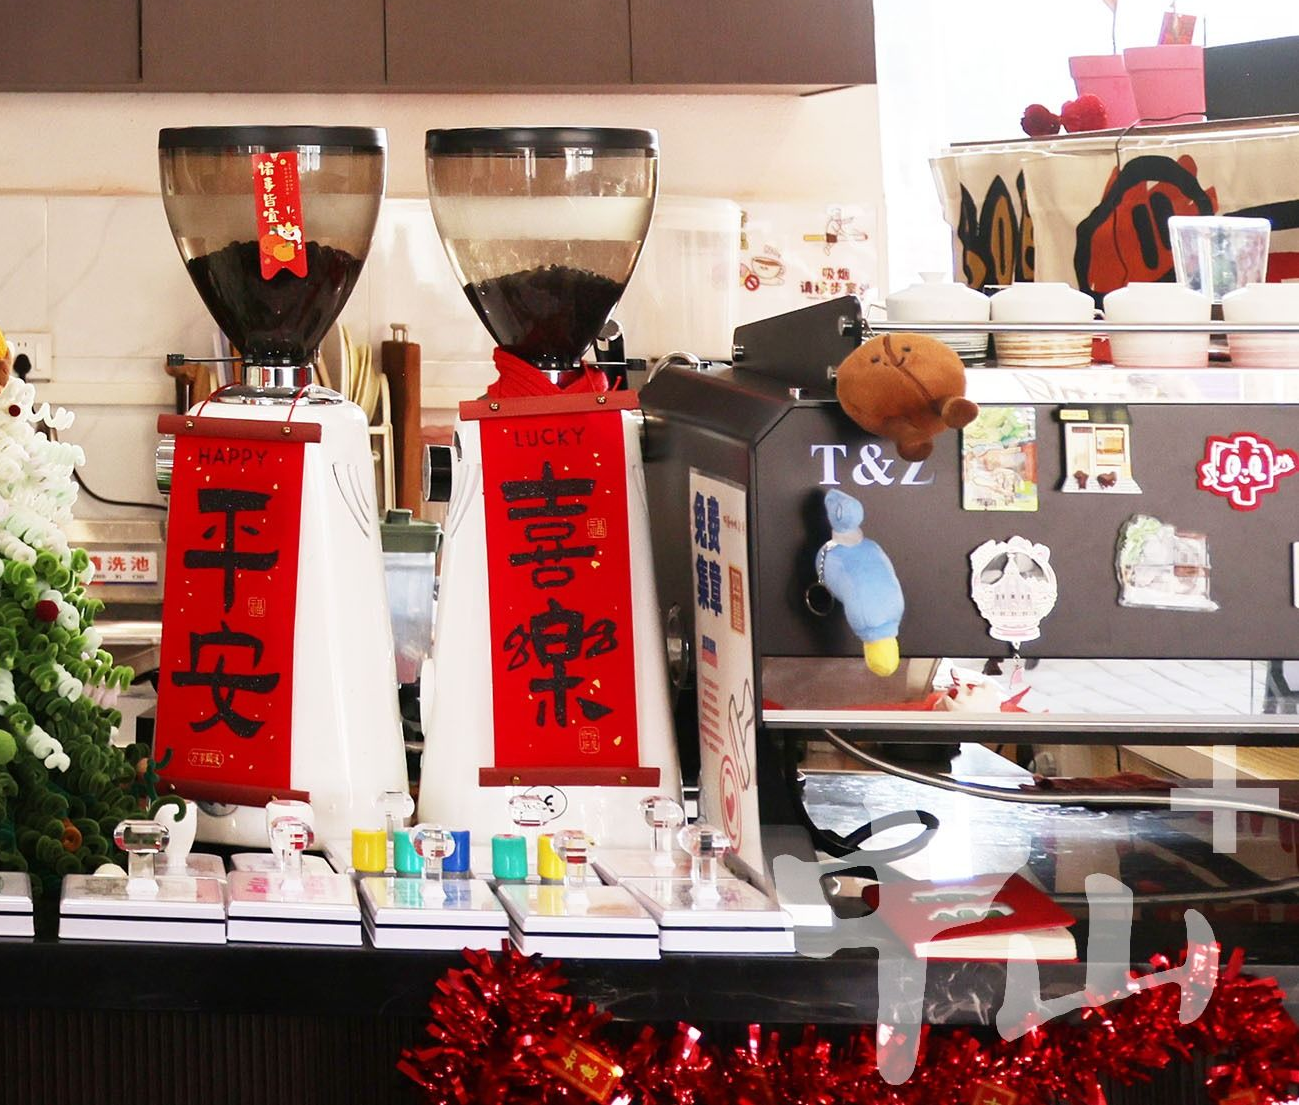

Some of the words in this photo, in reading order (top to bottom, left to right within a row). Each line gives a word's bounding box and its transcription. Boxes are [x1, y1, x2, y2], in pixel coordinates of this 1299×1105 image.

[822, 267, 850, 280] 吸烟
[514, 427, 586, 447] LUCKY
[198, 447, 269, 465] HAPPY
[171, 487, 281, 738] 平安
